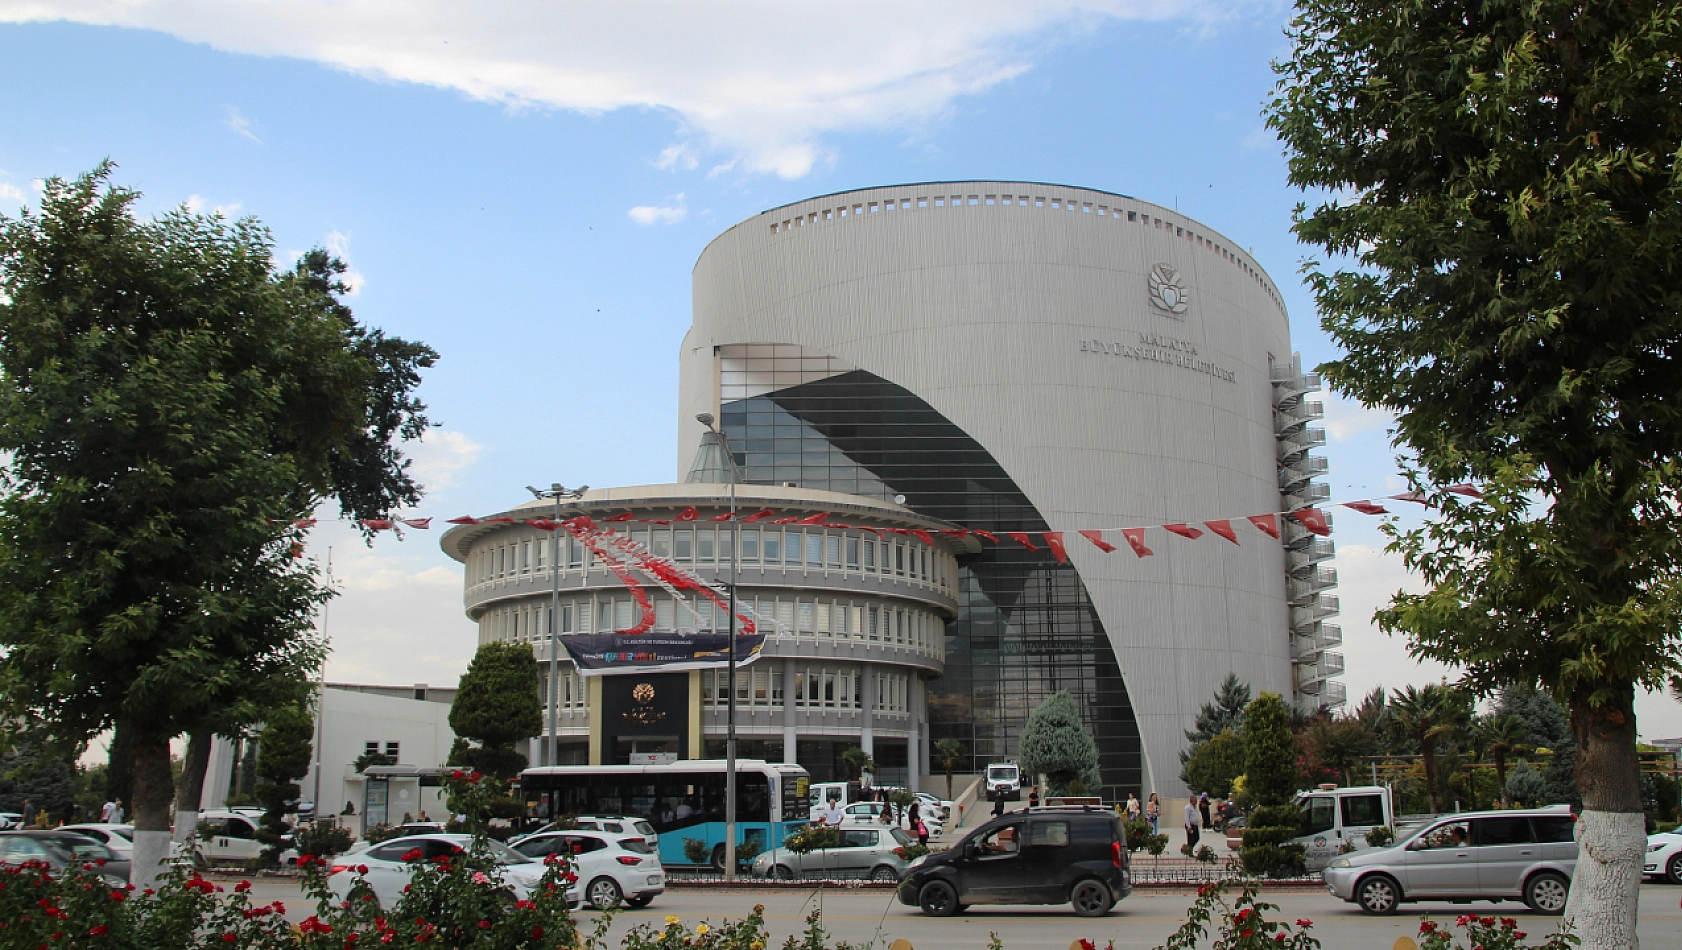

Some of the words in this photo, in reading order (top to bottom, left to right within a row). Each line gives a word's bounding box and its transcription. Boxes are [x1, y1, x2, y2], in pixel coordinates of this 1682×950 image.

[1139, 332, 1198, 356] MALATYA
[1079, 339, 1173, 365] BÜYÜKŞEHİR
[1176, 354, 1237, 384] BELEDİYESİ
